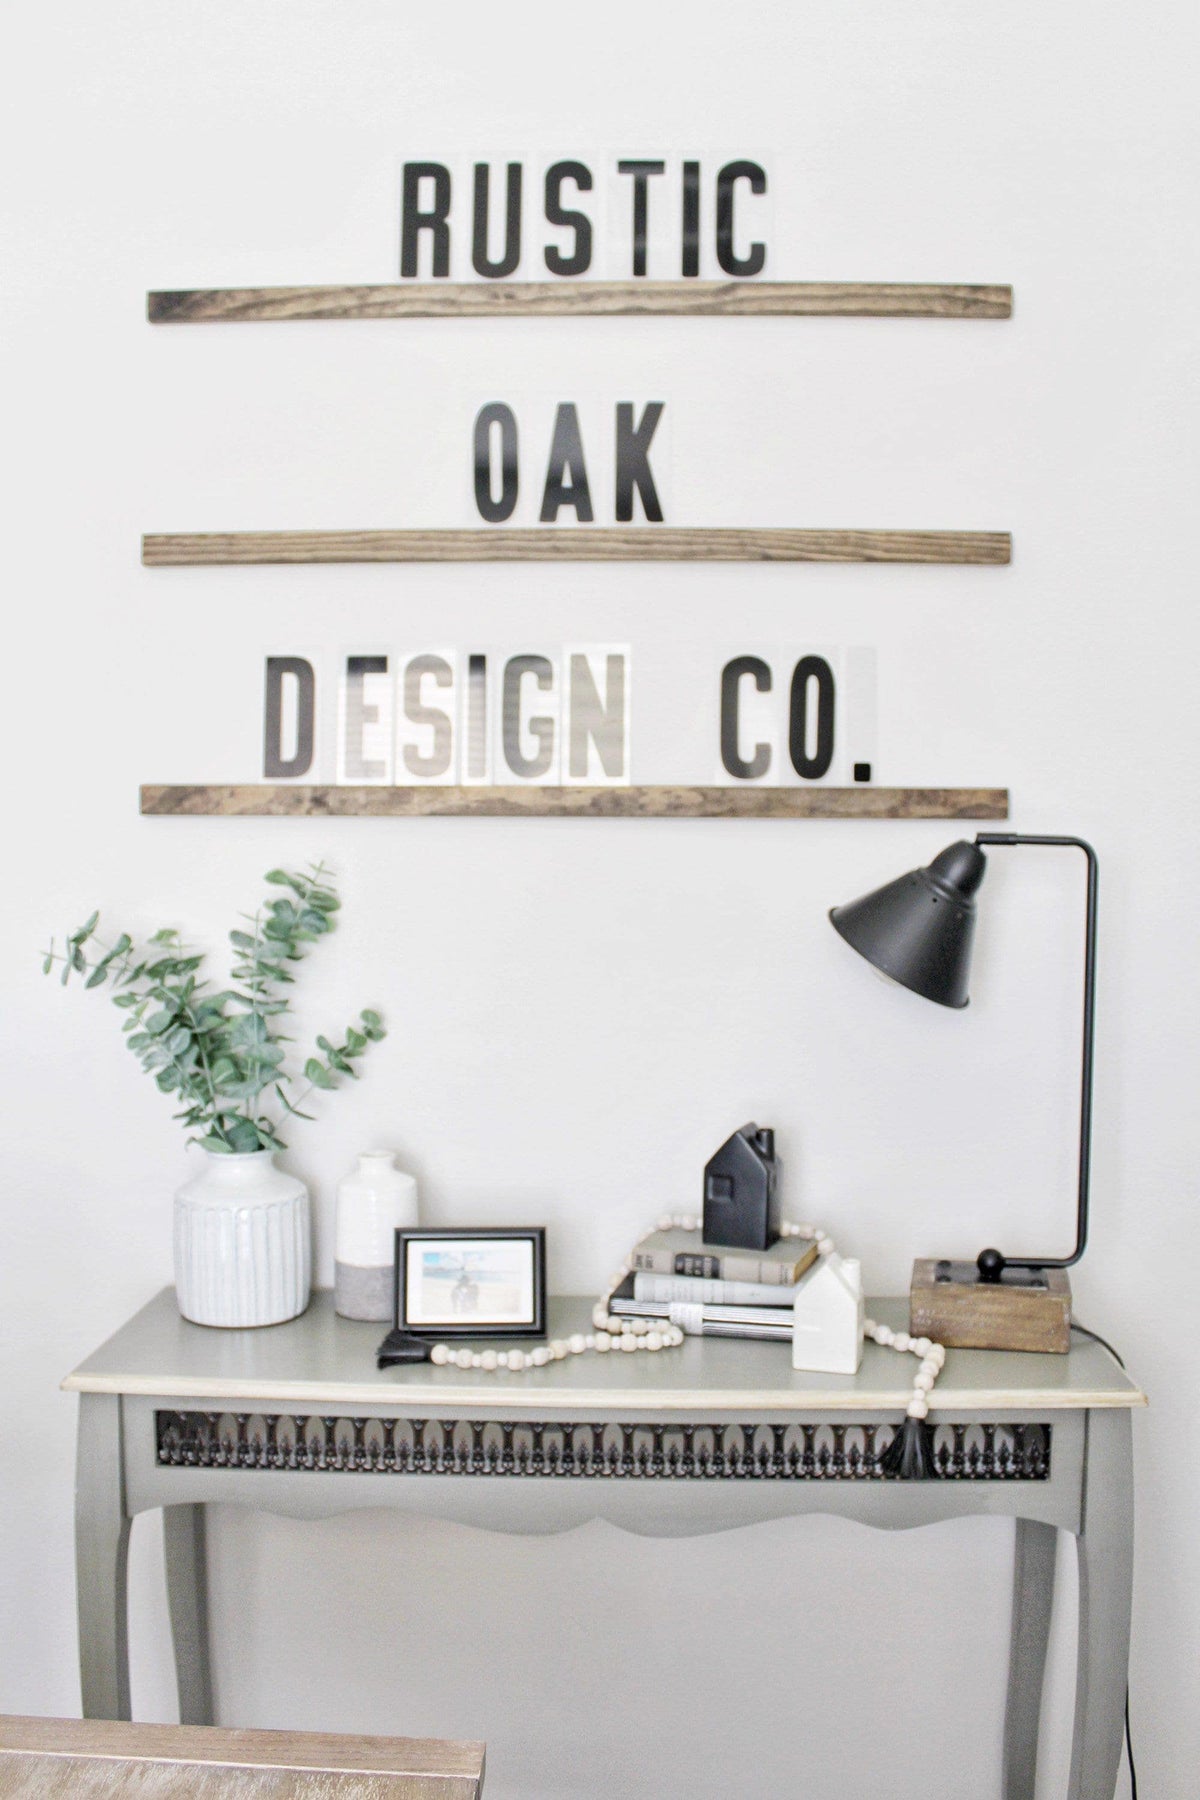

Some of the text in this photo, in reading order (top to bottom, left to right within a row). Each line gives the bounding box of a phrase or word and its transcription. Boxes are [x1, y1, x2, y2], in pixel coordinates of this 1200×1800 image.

[401, 160, 767, 278] RUSTIC
[474, 402, 665, 523] OAK
[263, 654, 872, 782] DESIGN CO.
